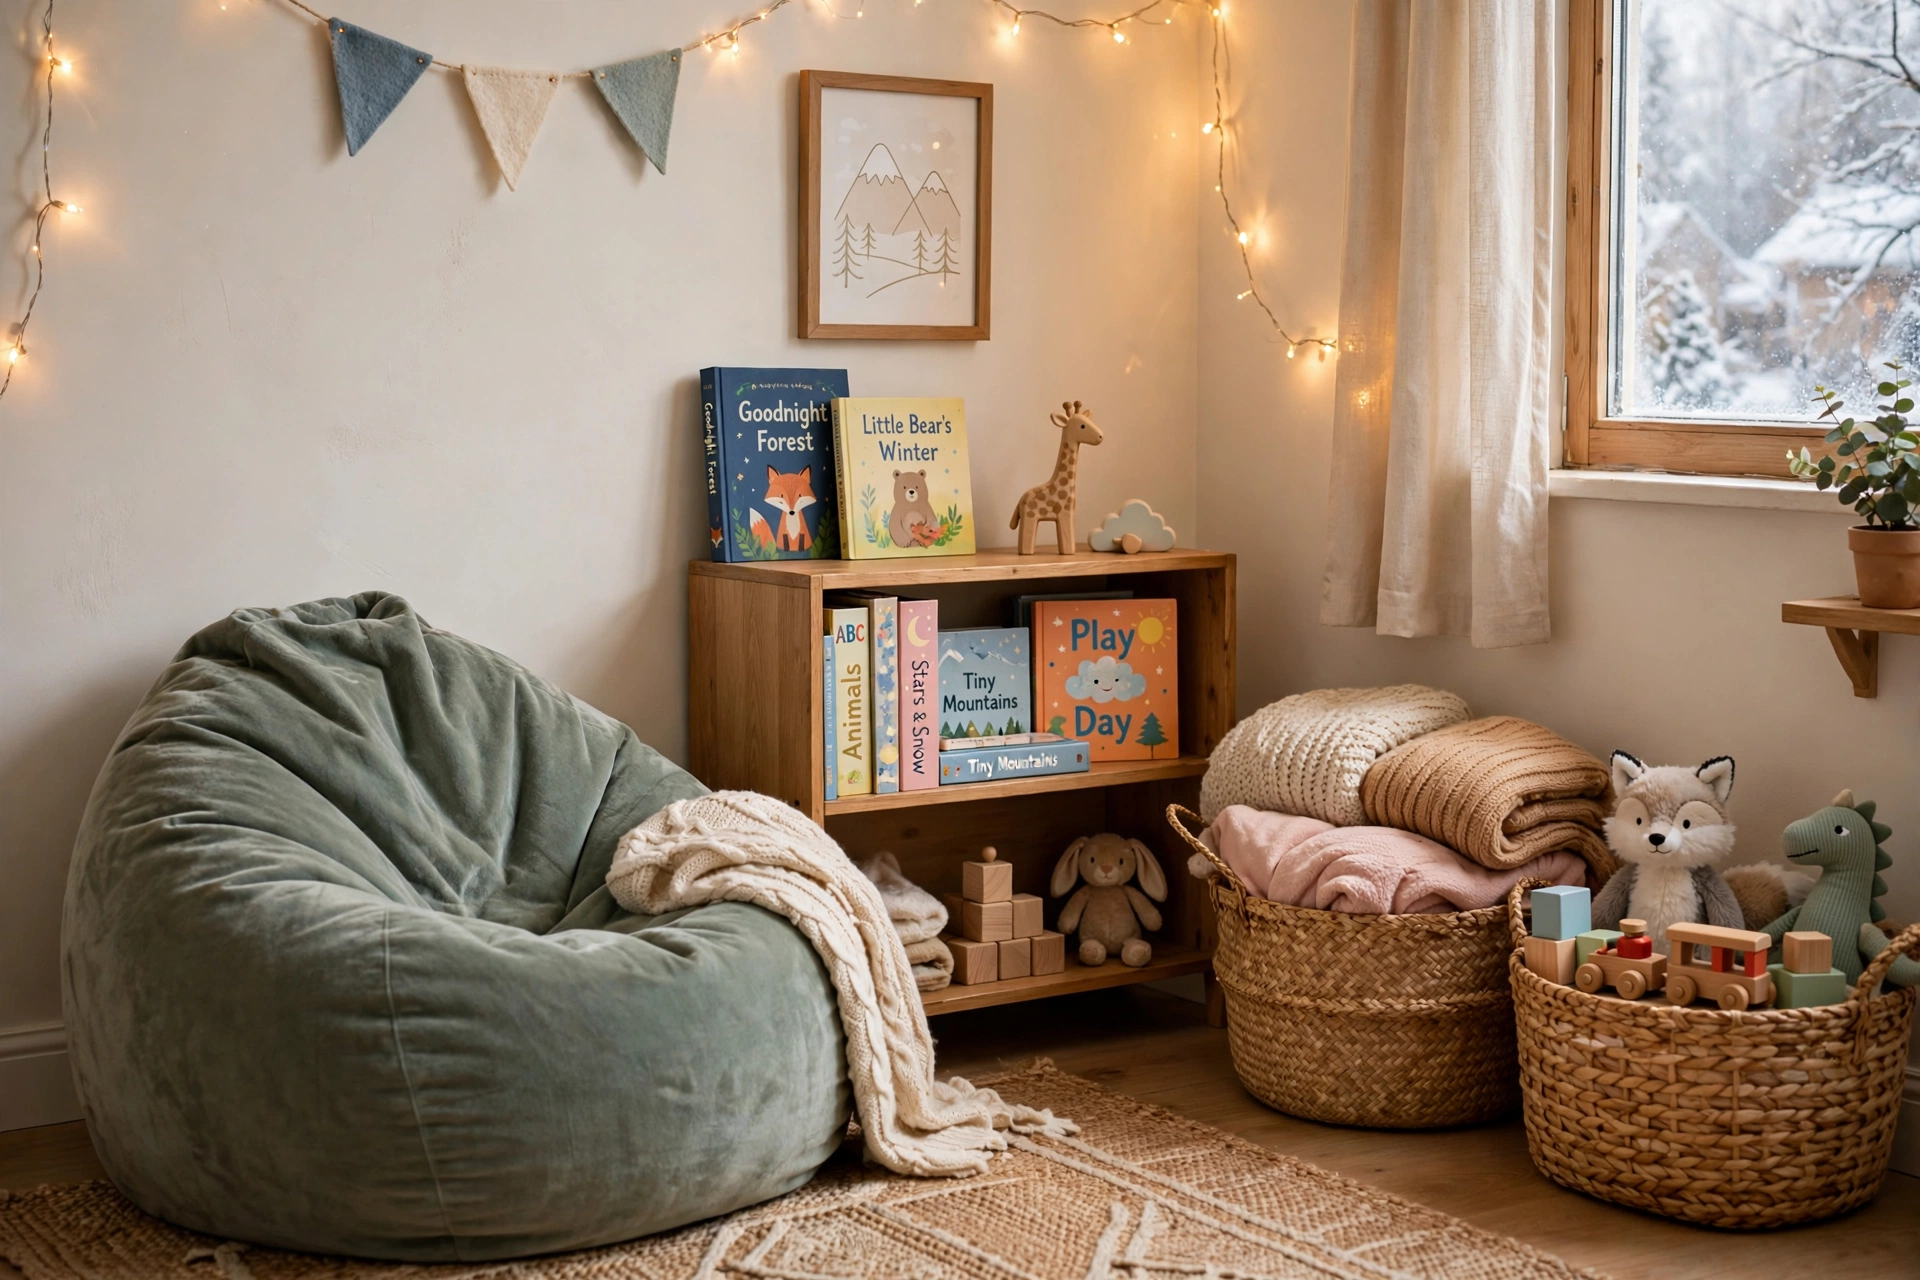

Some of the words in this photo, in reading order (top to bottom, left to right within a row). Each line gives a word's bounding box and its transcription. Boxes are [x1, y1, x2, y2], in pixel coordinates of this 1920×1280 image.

[738, 400, 828, 429] Goodnight
[862, 413, 904, 435] Little
[909, 413, 952, 434] Bear's
[757, 429, 815, 452] Forest
[878, 440, 939, 461] Winter
[835, 623, 865, 644] ABC
[1070, 618, 1136, 660] Play
[911, 660, 930, 706] Stars
[962, 672, 996, 694] Tiny
[841, 663, 863, 761] Animals
[942, 693, 1018, 713] Mountains
[913, 711, 927, 723] &
[1074, 705, 1132, 745] Day
[912, 726, 930, 775] Snow
[967, 758, 993, 778] Tiny
[997, 752, 1059, 773] Mountains
